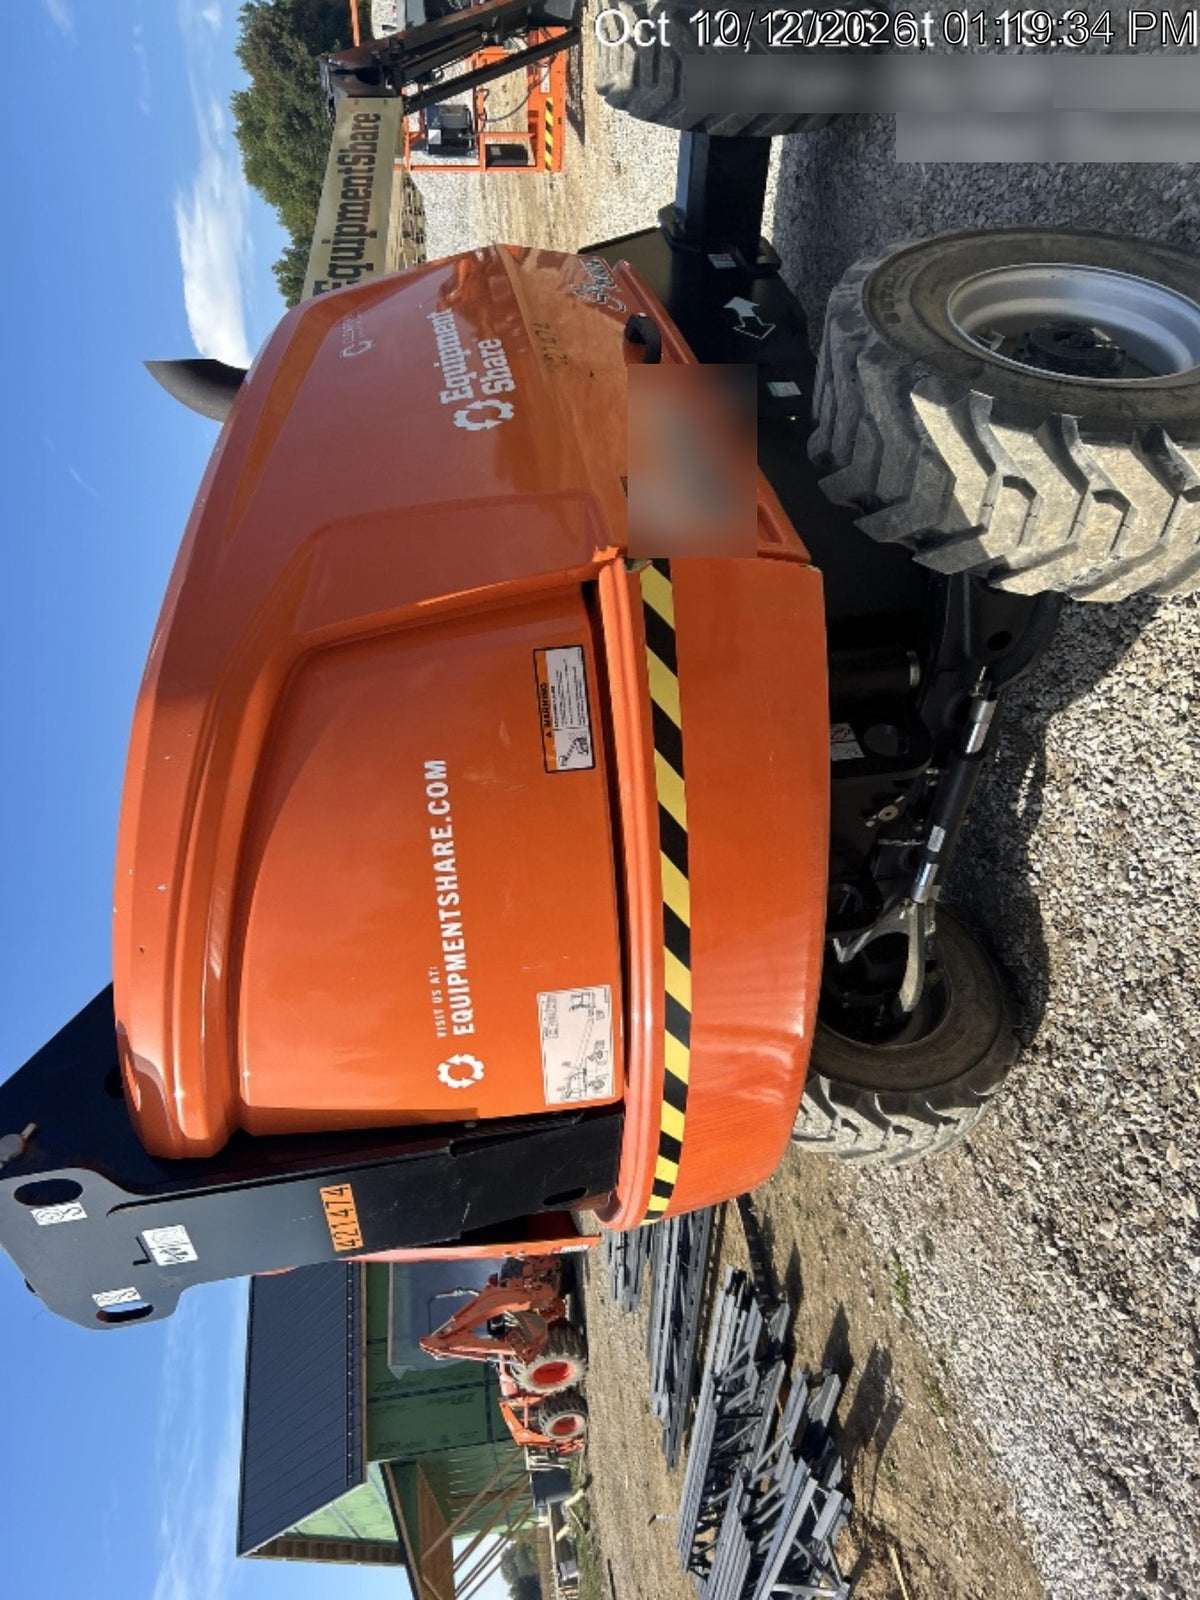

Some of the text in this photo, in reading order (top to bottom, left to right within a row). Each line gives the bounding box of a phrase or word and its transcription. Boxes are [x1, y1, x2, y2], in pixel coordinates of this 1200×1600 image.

[427, 308, 477, 404] Equipment
[477, 339, 516, 395] Share
[423, 760, 475, 1036] EQUIPMENTSHARE.COM
[428, 966, 447, 1038] VISIT US AT:
[320, 1186, 361, 1247] 421474
